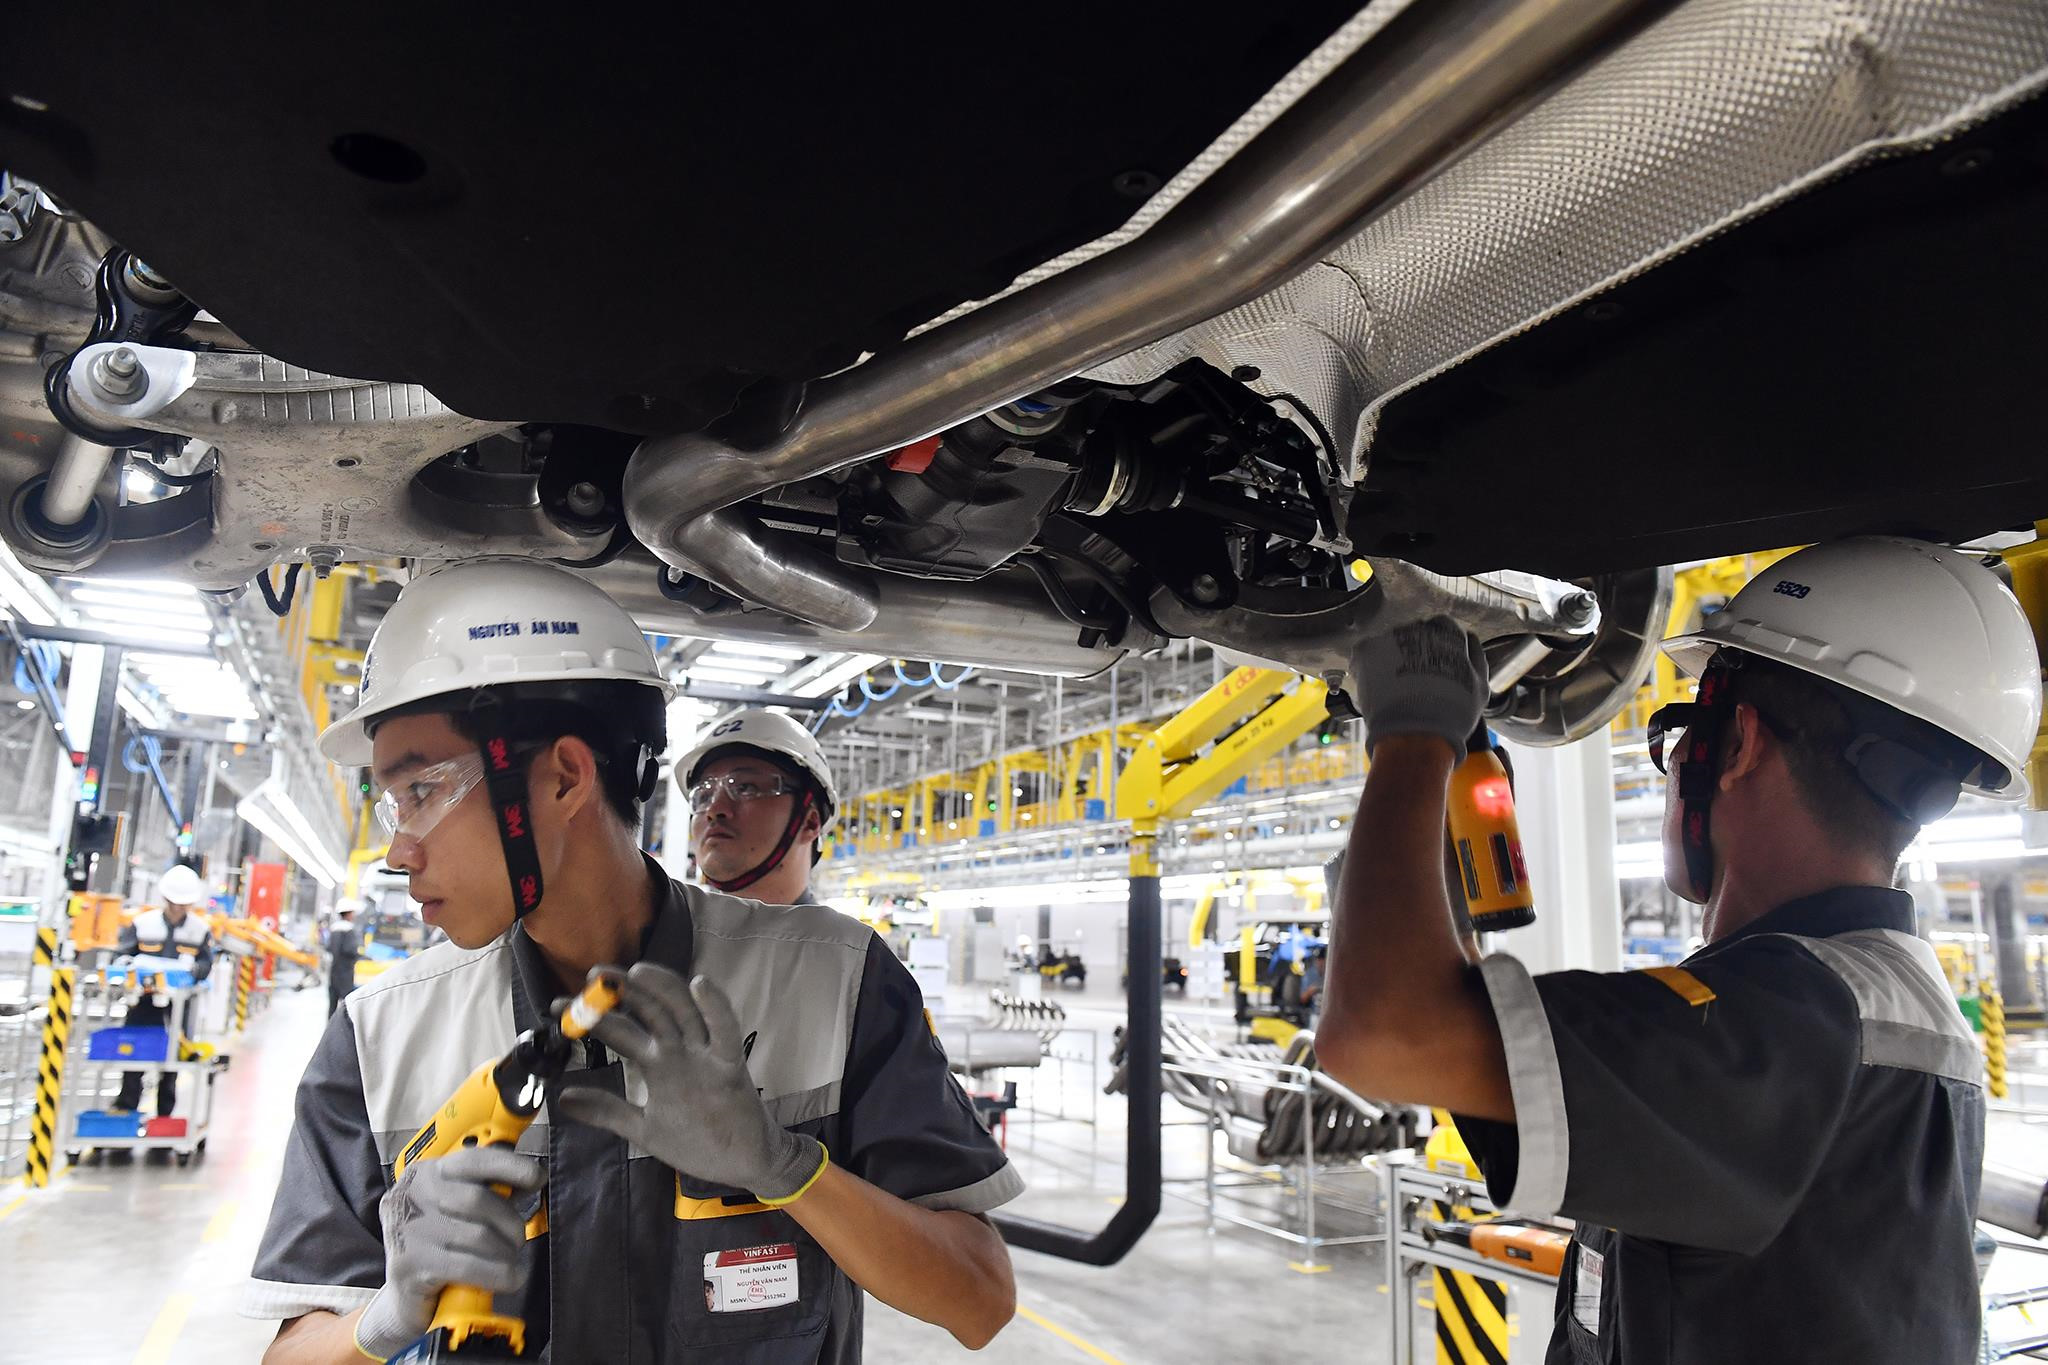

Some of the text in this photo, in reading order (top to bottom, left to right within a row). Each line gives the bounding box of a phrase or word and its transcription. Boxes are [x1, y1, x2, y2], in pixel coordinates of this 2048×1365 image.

[1773, 581, 1811, 599] 5529
[551, 621, 579, 635] NAM
[487, 738, 511, 771] 3M
[504, 804, 525, 838] 3M
[519, 874, 537, 908] 3M
[743, 1247, 779, 1257] VINFAST
